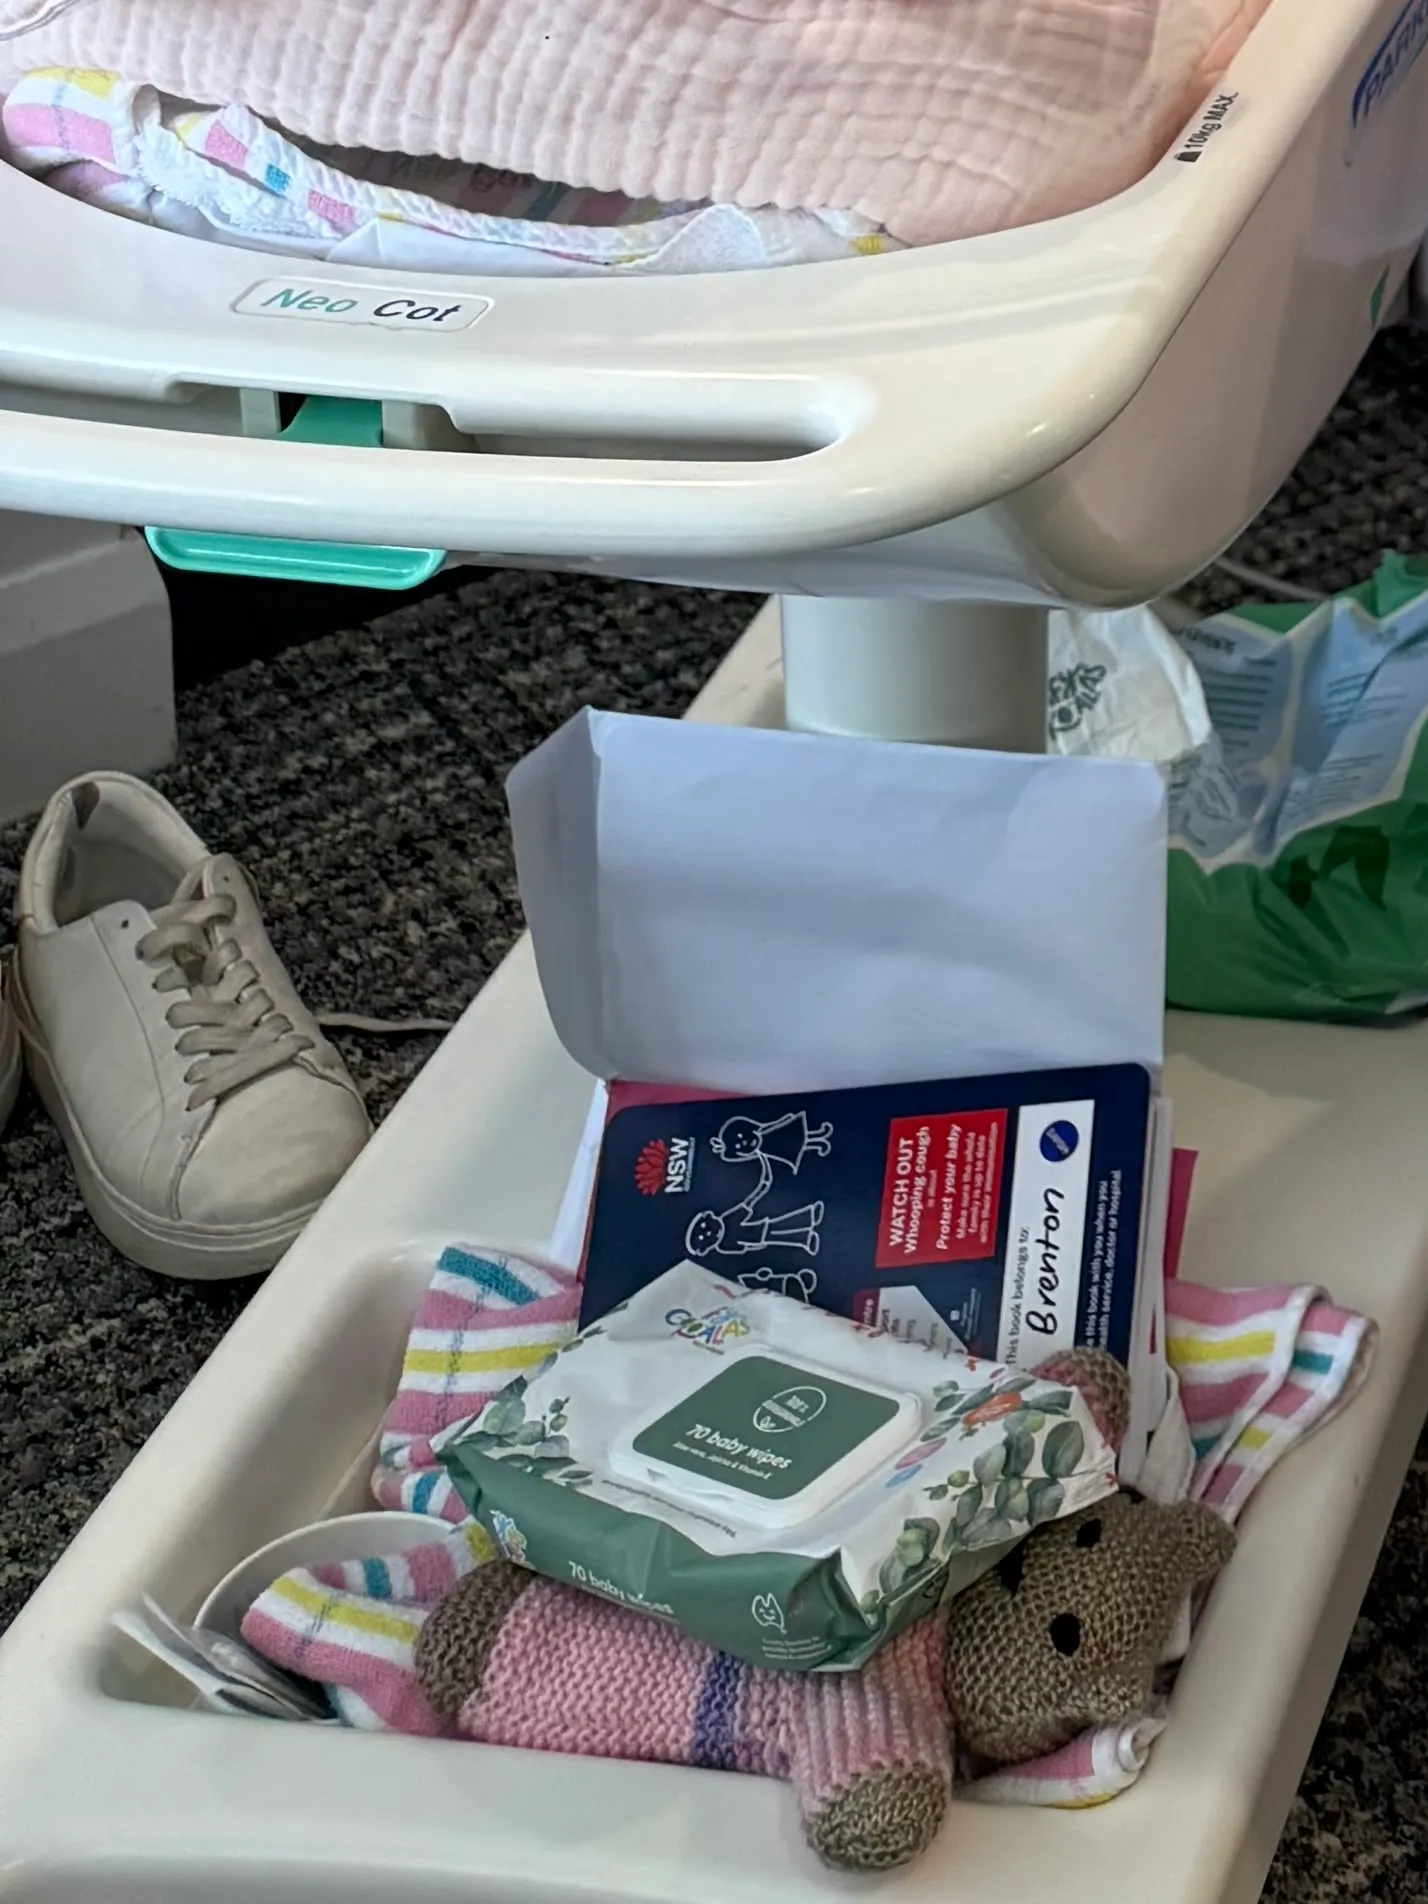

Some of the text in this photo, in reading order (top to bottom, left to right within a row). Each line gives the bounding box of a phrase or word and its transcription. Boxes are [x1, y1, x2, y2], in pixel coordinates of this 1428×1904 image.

[261, 288, 462, 322] Neo Cot
[664, 1137, 688, 1193] NSW
[889, 1137, 914, 1246] WATCH OUT
[904, 1126, 931, 1253] Whooping cough
[936, 1124, 962, 1250] Protect your baby
[1095, 1180, 1109, 1203] you
[1094, 1203, 1106, 1234] when
[1025, 1186, 1066, 1335] Brenton
[1093, 1235, 1104, 1256] you
[1104, 1231, 1116, 1268] doctor
[1090, 1258, 1101, 1282] with
[1005, 1226, 1029, 1365] This book belongs to:
[1087, 1284, 1099, 1313] book
[1084, 1315, 1096, 1336] this
[686, 1423, 792, 1470] 70 baby wipes
[568, 1561, 586, 1581] 70
